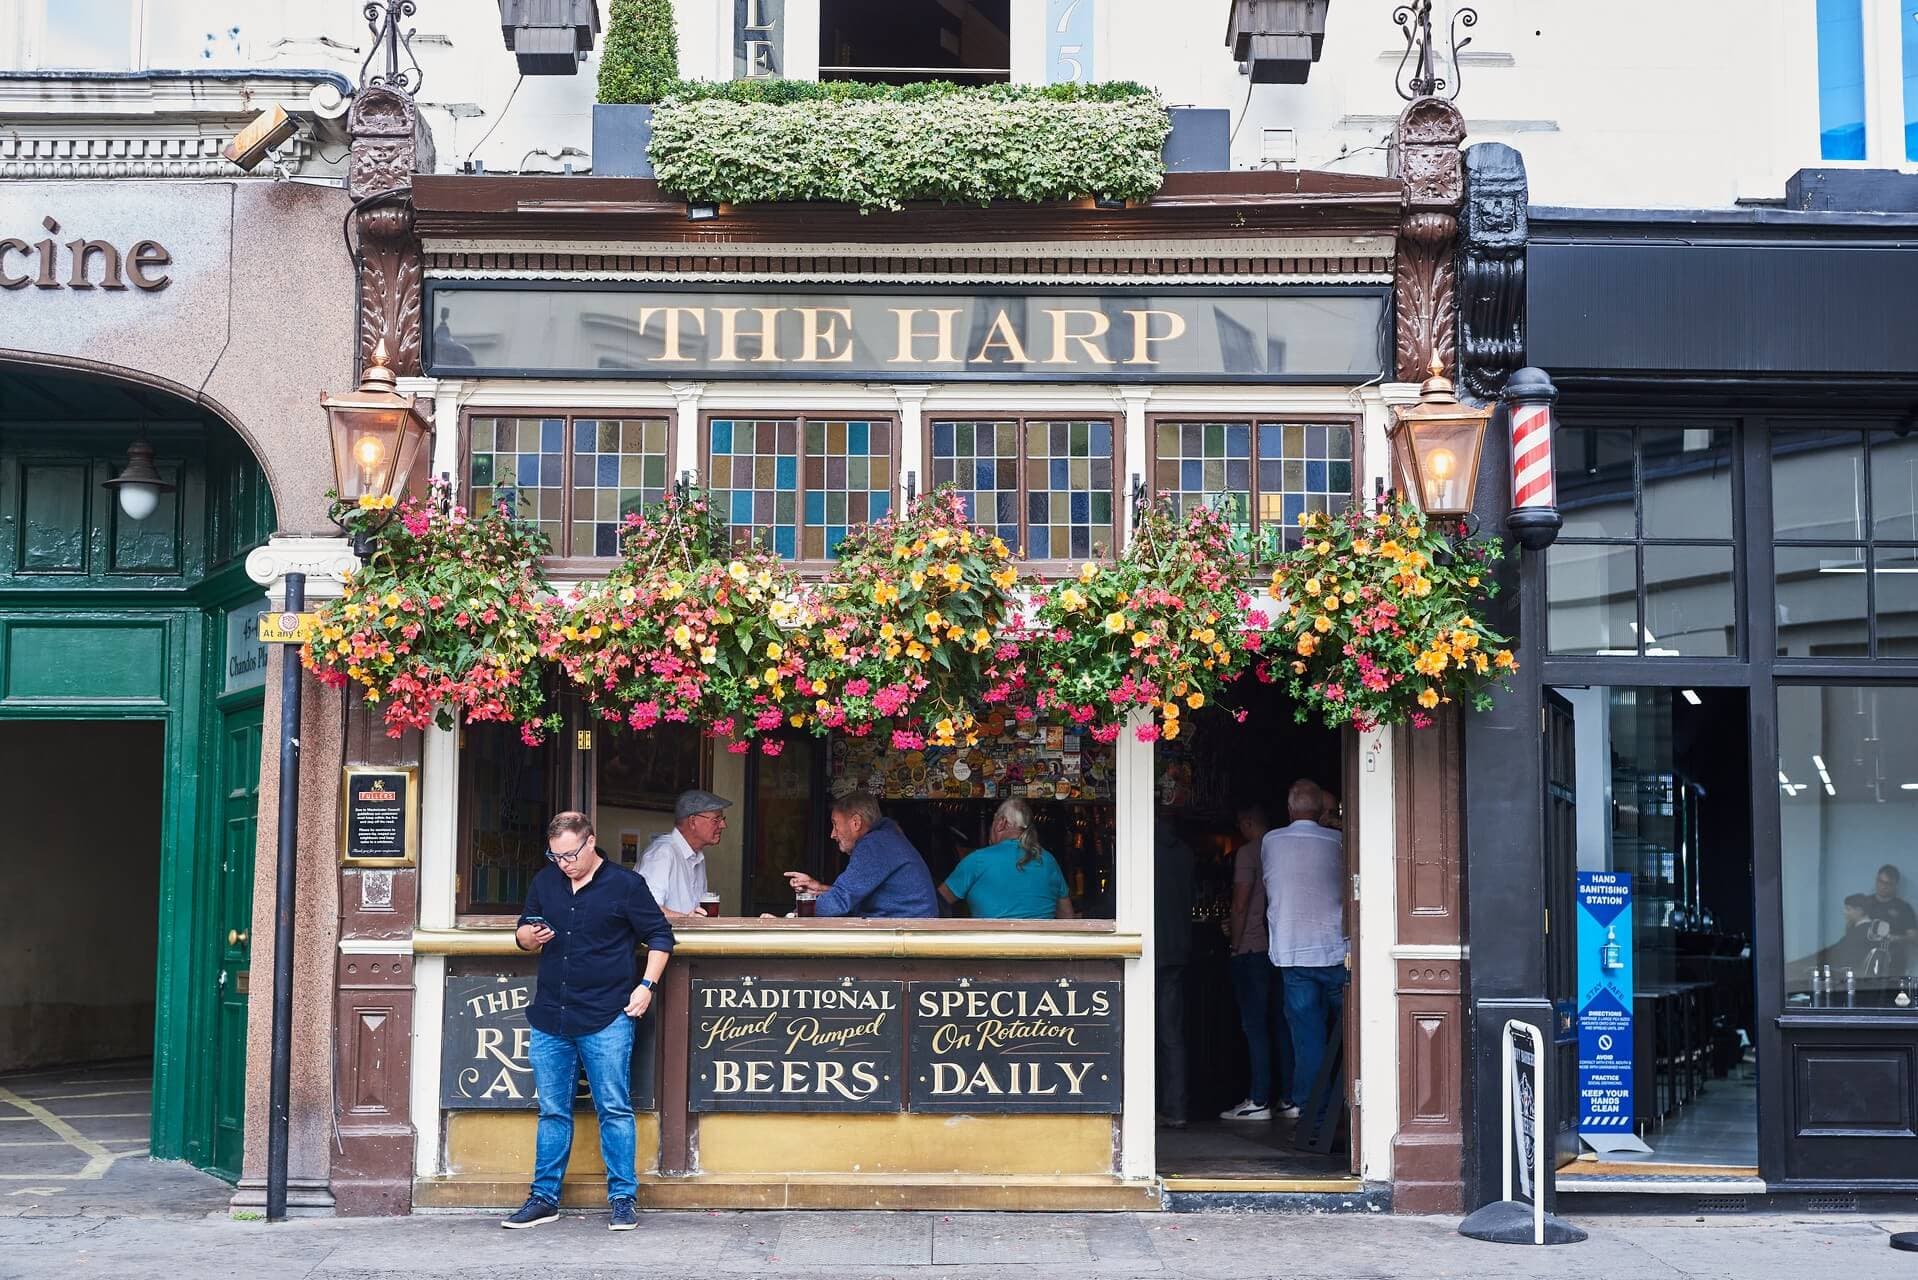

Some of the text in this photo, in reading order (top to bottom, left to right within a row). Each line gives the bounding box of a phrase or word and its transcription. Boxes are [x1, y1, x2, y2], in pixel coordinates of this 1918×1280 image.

[0, 216, 171, 290] cine
[639, 307, 1188, 365] THE HARP
[264, 630, 274, 638] At
[277, 630, 294, 638] any
[230, 646, 268, 677] Chandos Pla
[1580, 885, 1628, 894] SANITISING
[1592, 874, 1616, 883] HAND
[1586, 896, 1622, 904] STATION
[467, 987, 530, 1018] THE
[700, 988, 897, 1010] TRADITIONAL
[918, 990, 1110, 1018] SPECIALS
[1586, 981, 1624, 1000] STAY SAFE
[698, 1011, 887, 1055] Hand Pumped
[931, 1018, 1080, 1055] On Rotation
[474, 1028, 534, 1072] RE
[712, 1060, 880, 1100] BEERS
[930, 1062, 1095, 1095] DAILY
